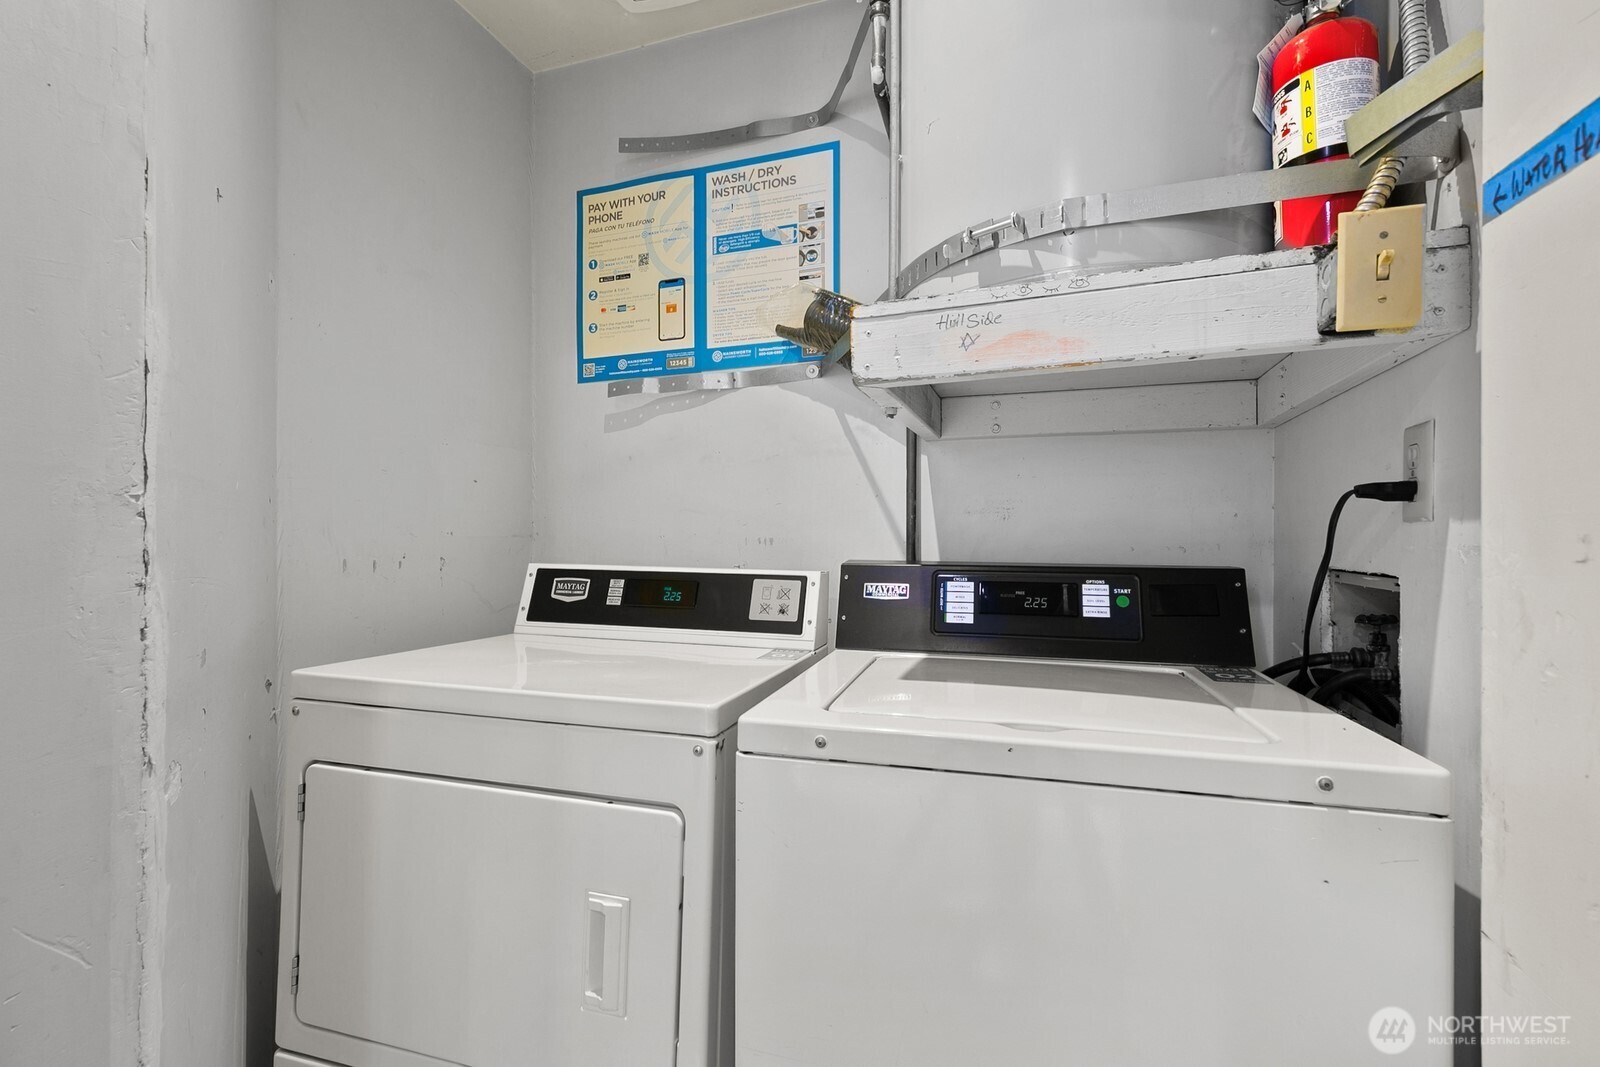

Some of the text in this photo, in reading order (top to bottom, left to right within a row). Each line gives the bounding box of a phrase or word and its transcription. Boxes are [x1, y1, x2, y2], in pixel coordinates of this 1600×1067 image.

[1304, 80, 1311, 92] A
[1306, 106, 1312, 118] B
[1306, 132, 1312, 144] C
[711, 172, 746, 186] WASH
[758, 165, 782, 178] DRY
[712, 175, 797, 199] INSTRUCTIONS
[588, 190, 666, 214] PAY WITH YOUR
[588, 211, 623, 225] PHONE
[556, 582, 586, 590] MAYTAG
[866, 584, 907, 594] MAYTAG
[664, 592, 682, 602] 2.25
[1024, 596, 1048, 608] 2.25
